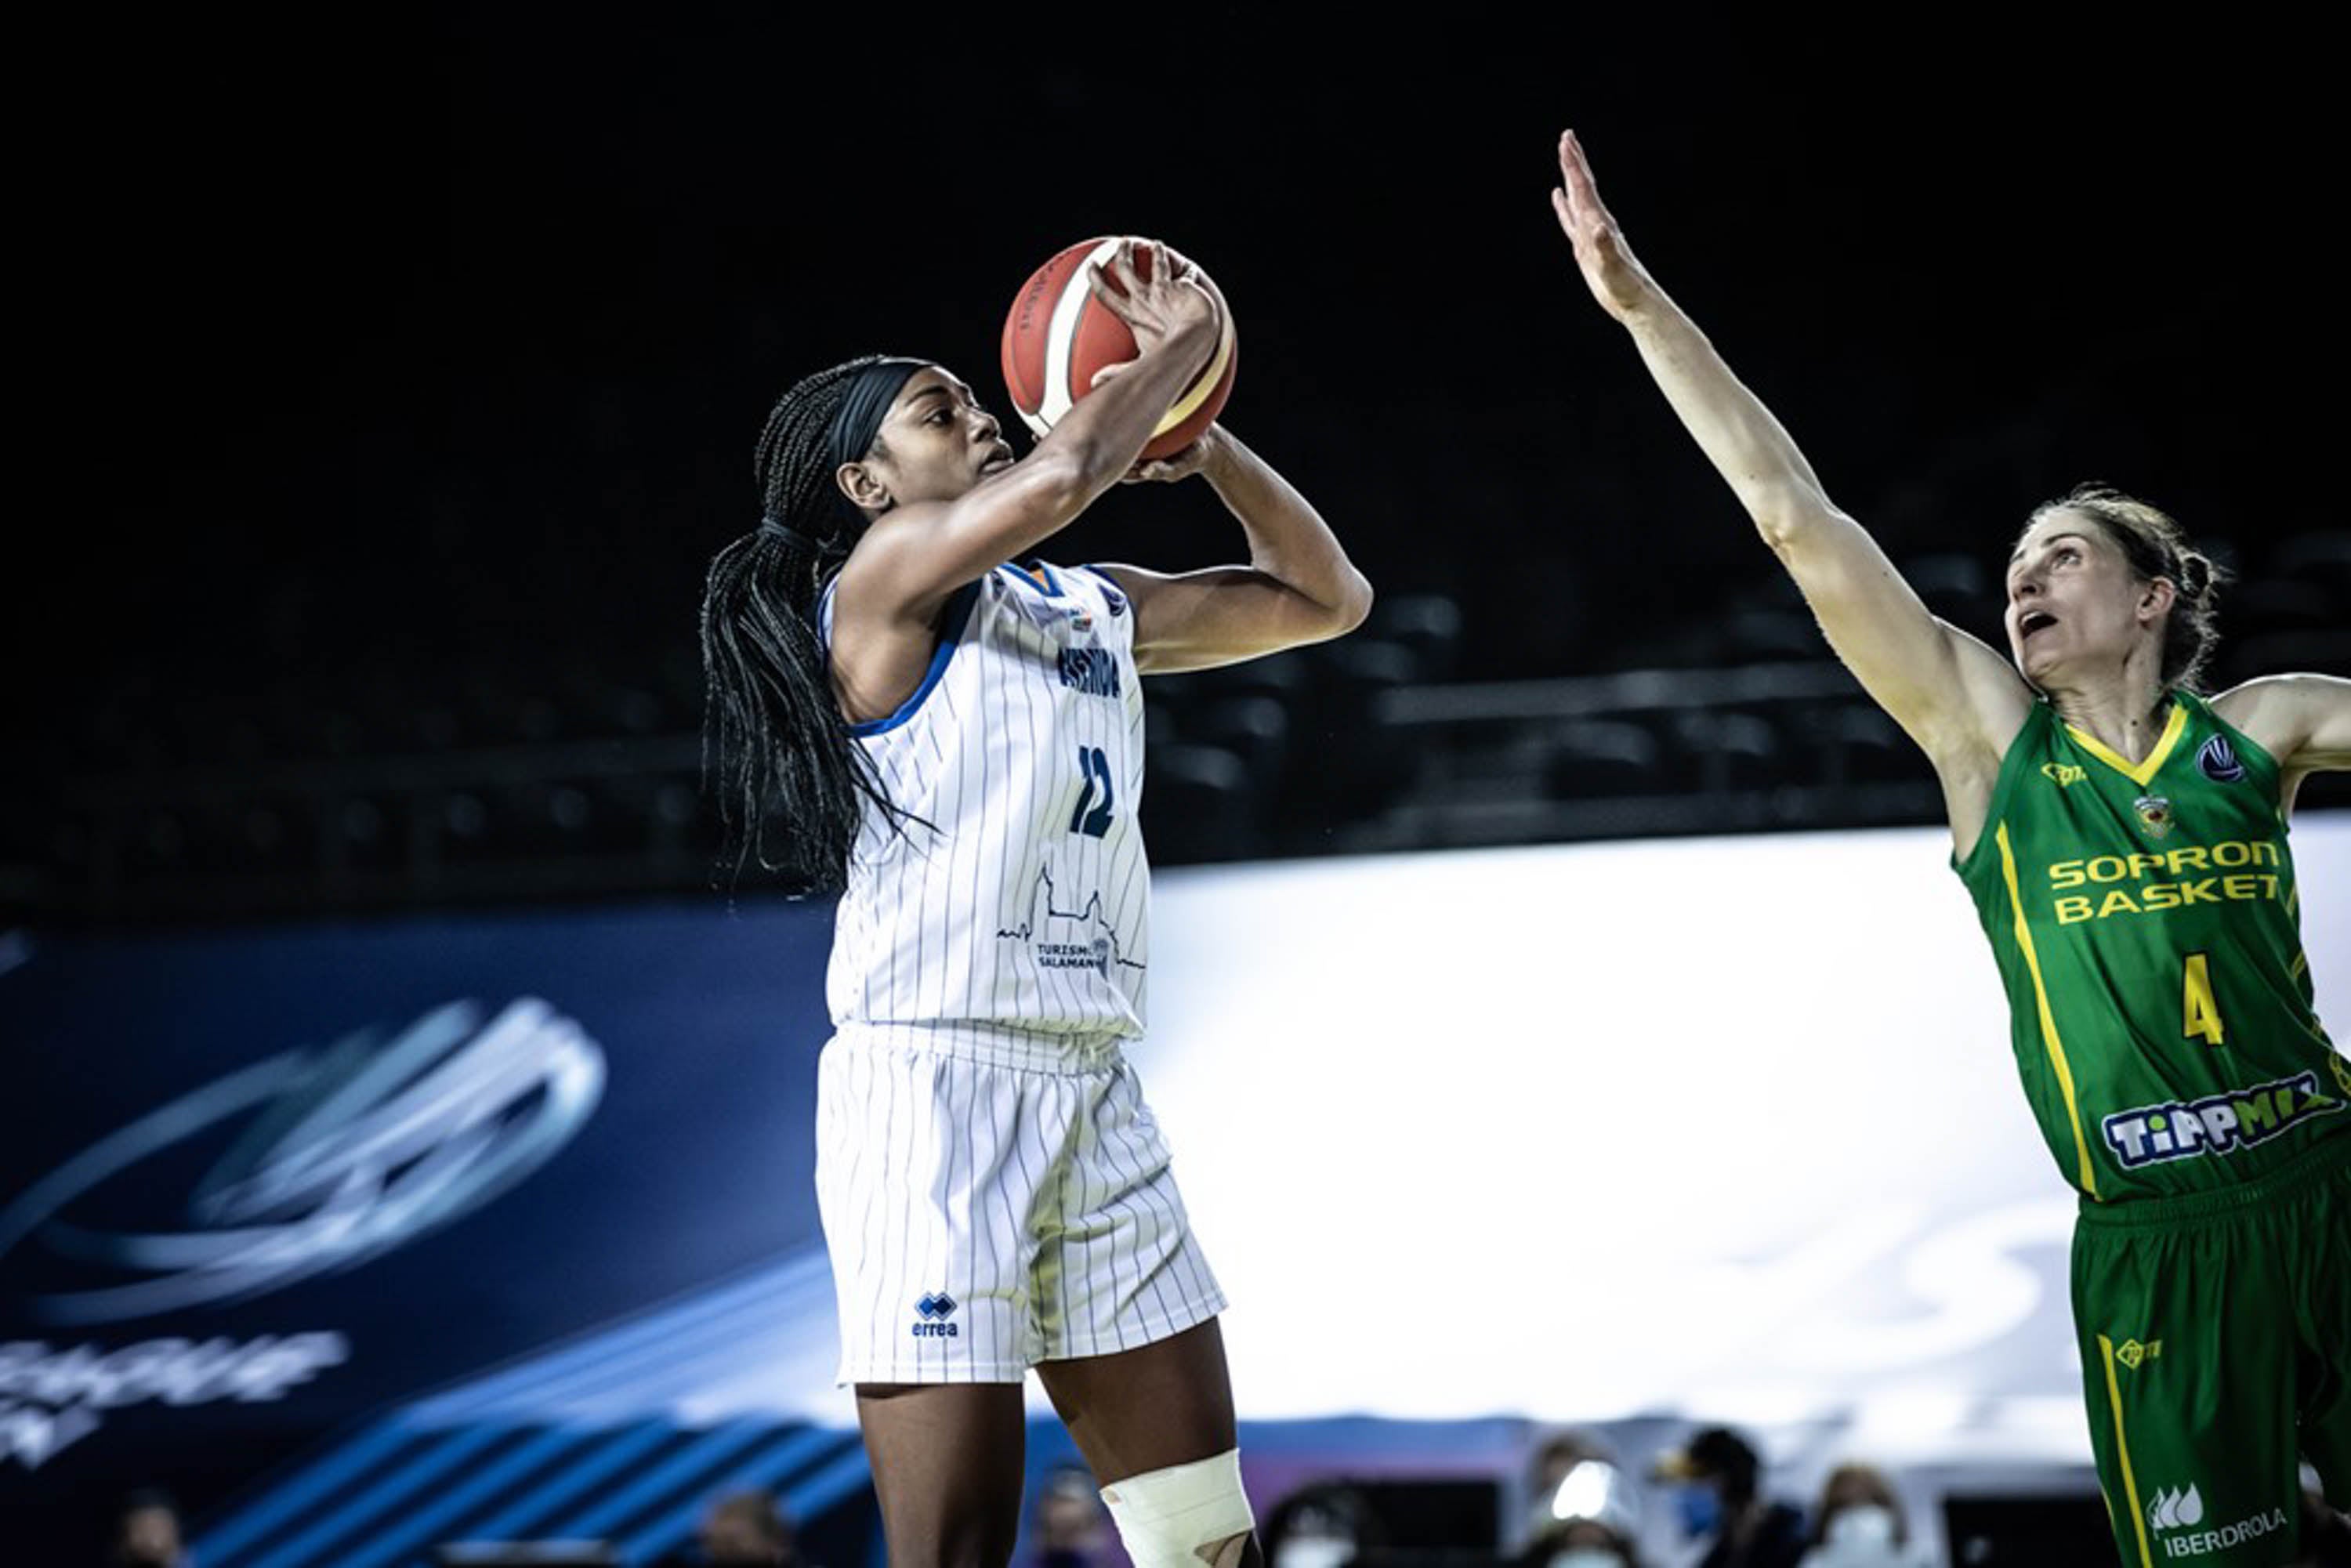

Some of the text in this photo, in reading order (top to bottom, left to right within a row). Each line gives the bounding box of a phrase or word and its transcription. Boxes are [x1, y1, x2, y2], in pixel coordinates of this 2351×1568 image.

[1069, 744, 1114, 839] 12
[2049, 841, 2280, 890] SOPRON
[2054, 874, 2279, 925] BASKET
[2184, 952, 2224, 1045] 4
[2164, 1506, 2288, 1558] IBERDROLA
